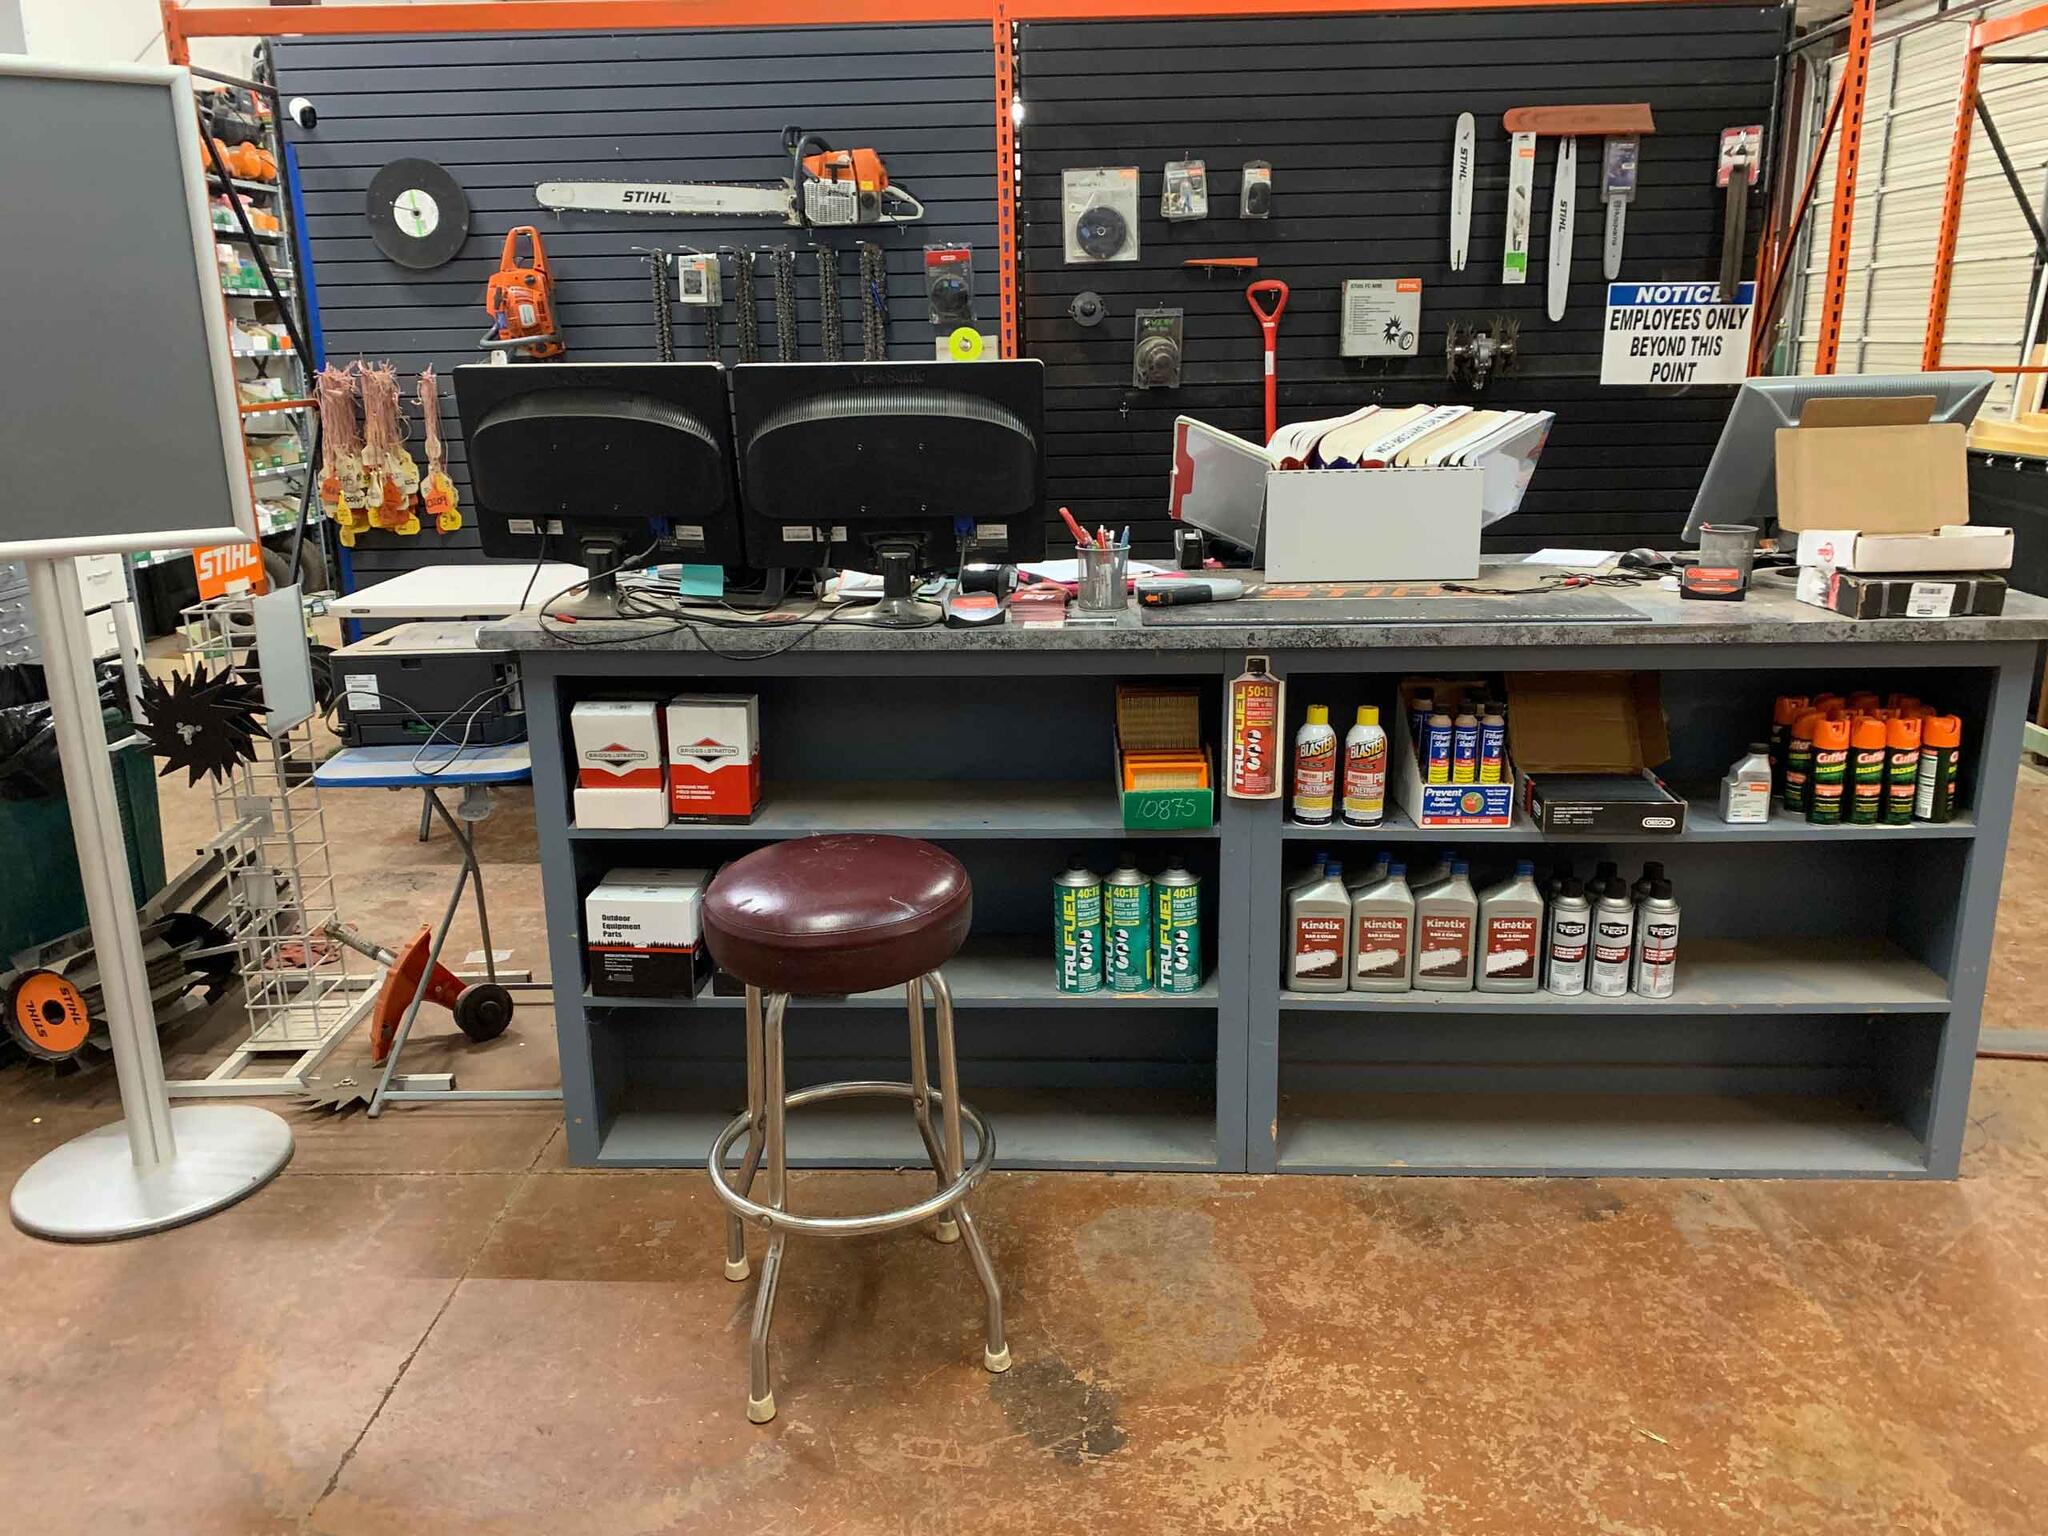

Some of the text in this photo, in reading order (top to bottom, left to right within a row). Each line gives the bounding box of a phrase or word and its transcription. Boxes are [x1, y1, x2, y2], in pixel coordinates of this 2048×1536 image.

[1459, 147, 1469, 181] STIHL
[622, 190, 672, 204] STIHL
[1558, 200, 1568, 233] STIHL
[1610, 308, 1749, 330] EMPLOYEES ONLY
[1630, 335, 1723, 356] BEYOND THIS
[1650, 362, 1697, 382] POINT
[199, 543, 257, 581] STIHL
[1234, 686, 1247, 786] TRUFUEL
[1425, 788, 1463, 797] Prevent
[1136, 798, 1196, 820] 10875
[602, 914, 630, 922] Outdoor
[602, 922, 641, 930] Equipment
[1302, 920, 1340, 930] Kinetix
[1364, 919, 1403, 929] Kinetix
[1426, 919, 1466, 928] Kinetix
[1493, 919, 1533, 929] Kinetix
[603, 930, 622, 938] Parts
[1063, 889, 1077, 989] TRUFUEL
[1104, 887, 1114, 984] TRUFUEL
[1160, 888, 1172, 988] TRUFUEL
[60, 985, 82, 1025] STIHL
[26, 1000, 47, 1037] STIHL
